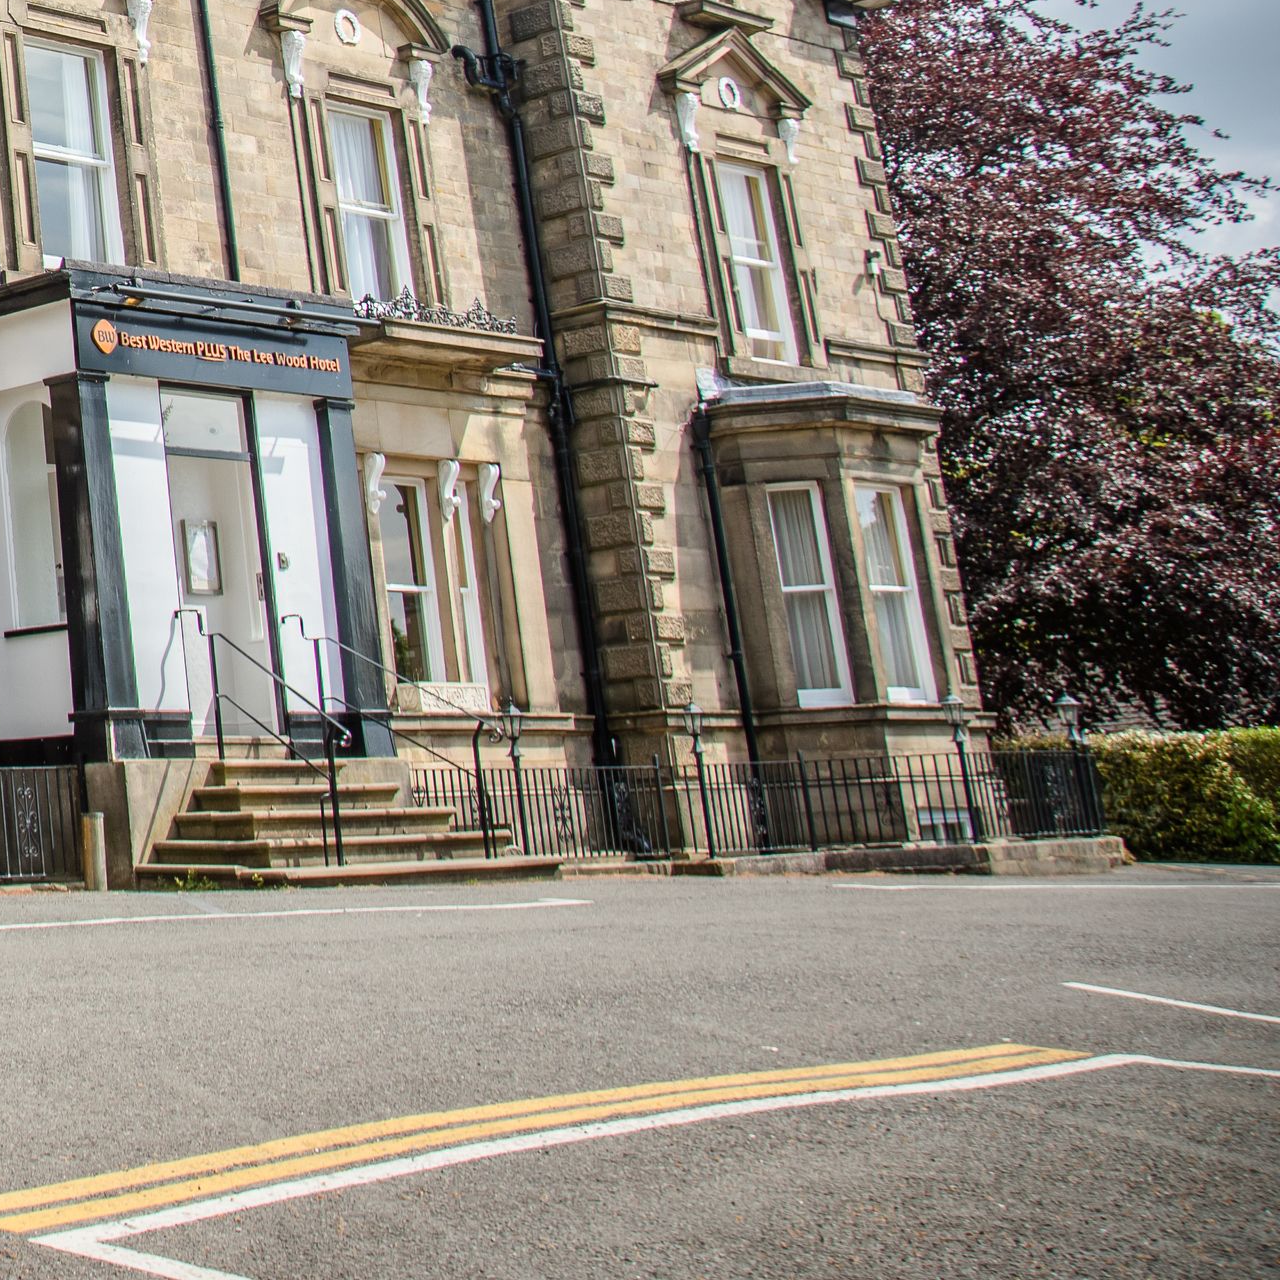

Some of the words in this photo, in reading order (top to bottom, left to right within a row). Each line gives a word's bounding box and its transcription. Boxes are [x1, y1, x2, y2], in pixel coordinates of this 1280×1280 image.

[120, 331, 147, 349] Best
[148, 335, 195, 355] Western
[197, 341, 227, 358] PLUS
[229, 346, 251, 361] The
[253, 349, 274, 364] Lee
[276, 351, 308, 369] Wood
[310, 355, 340, 372] Hotel
